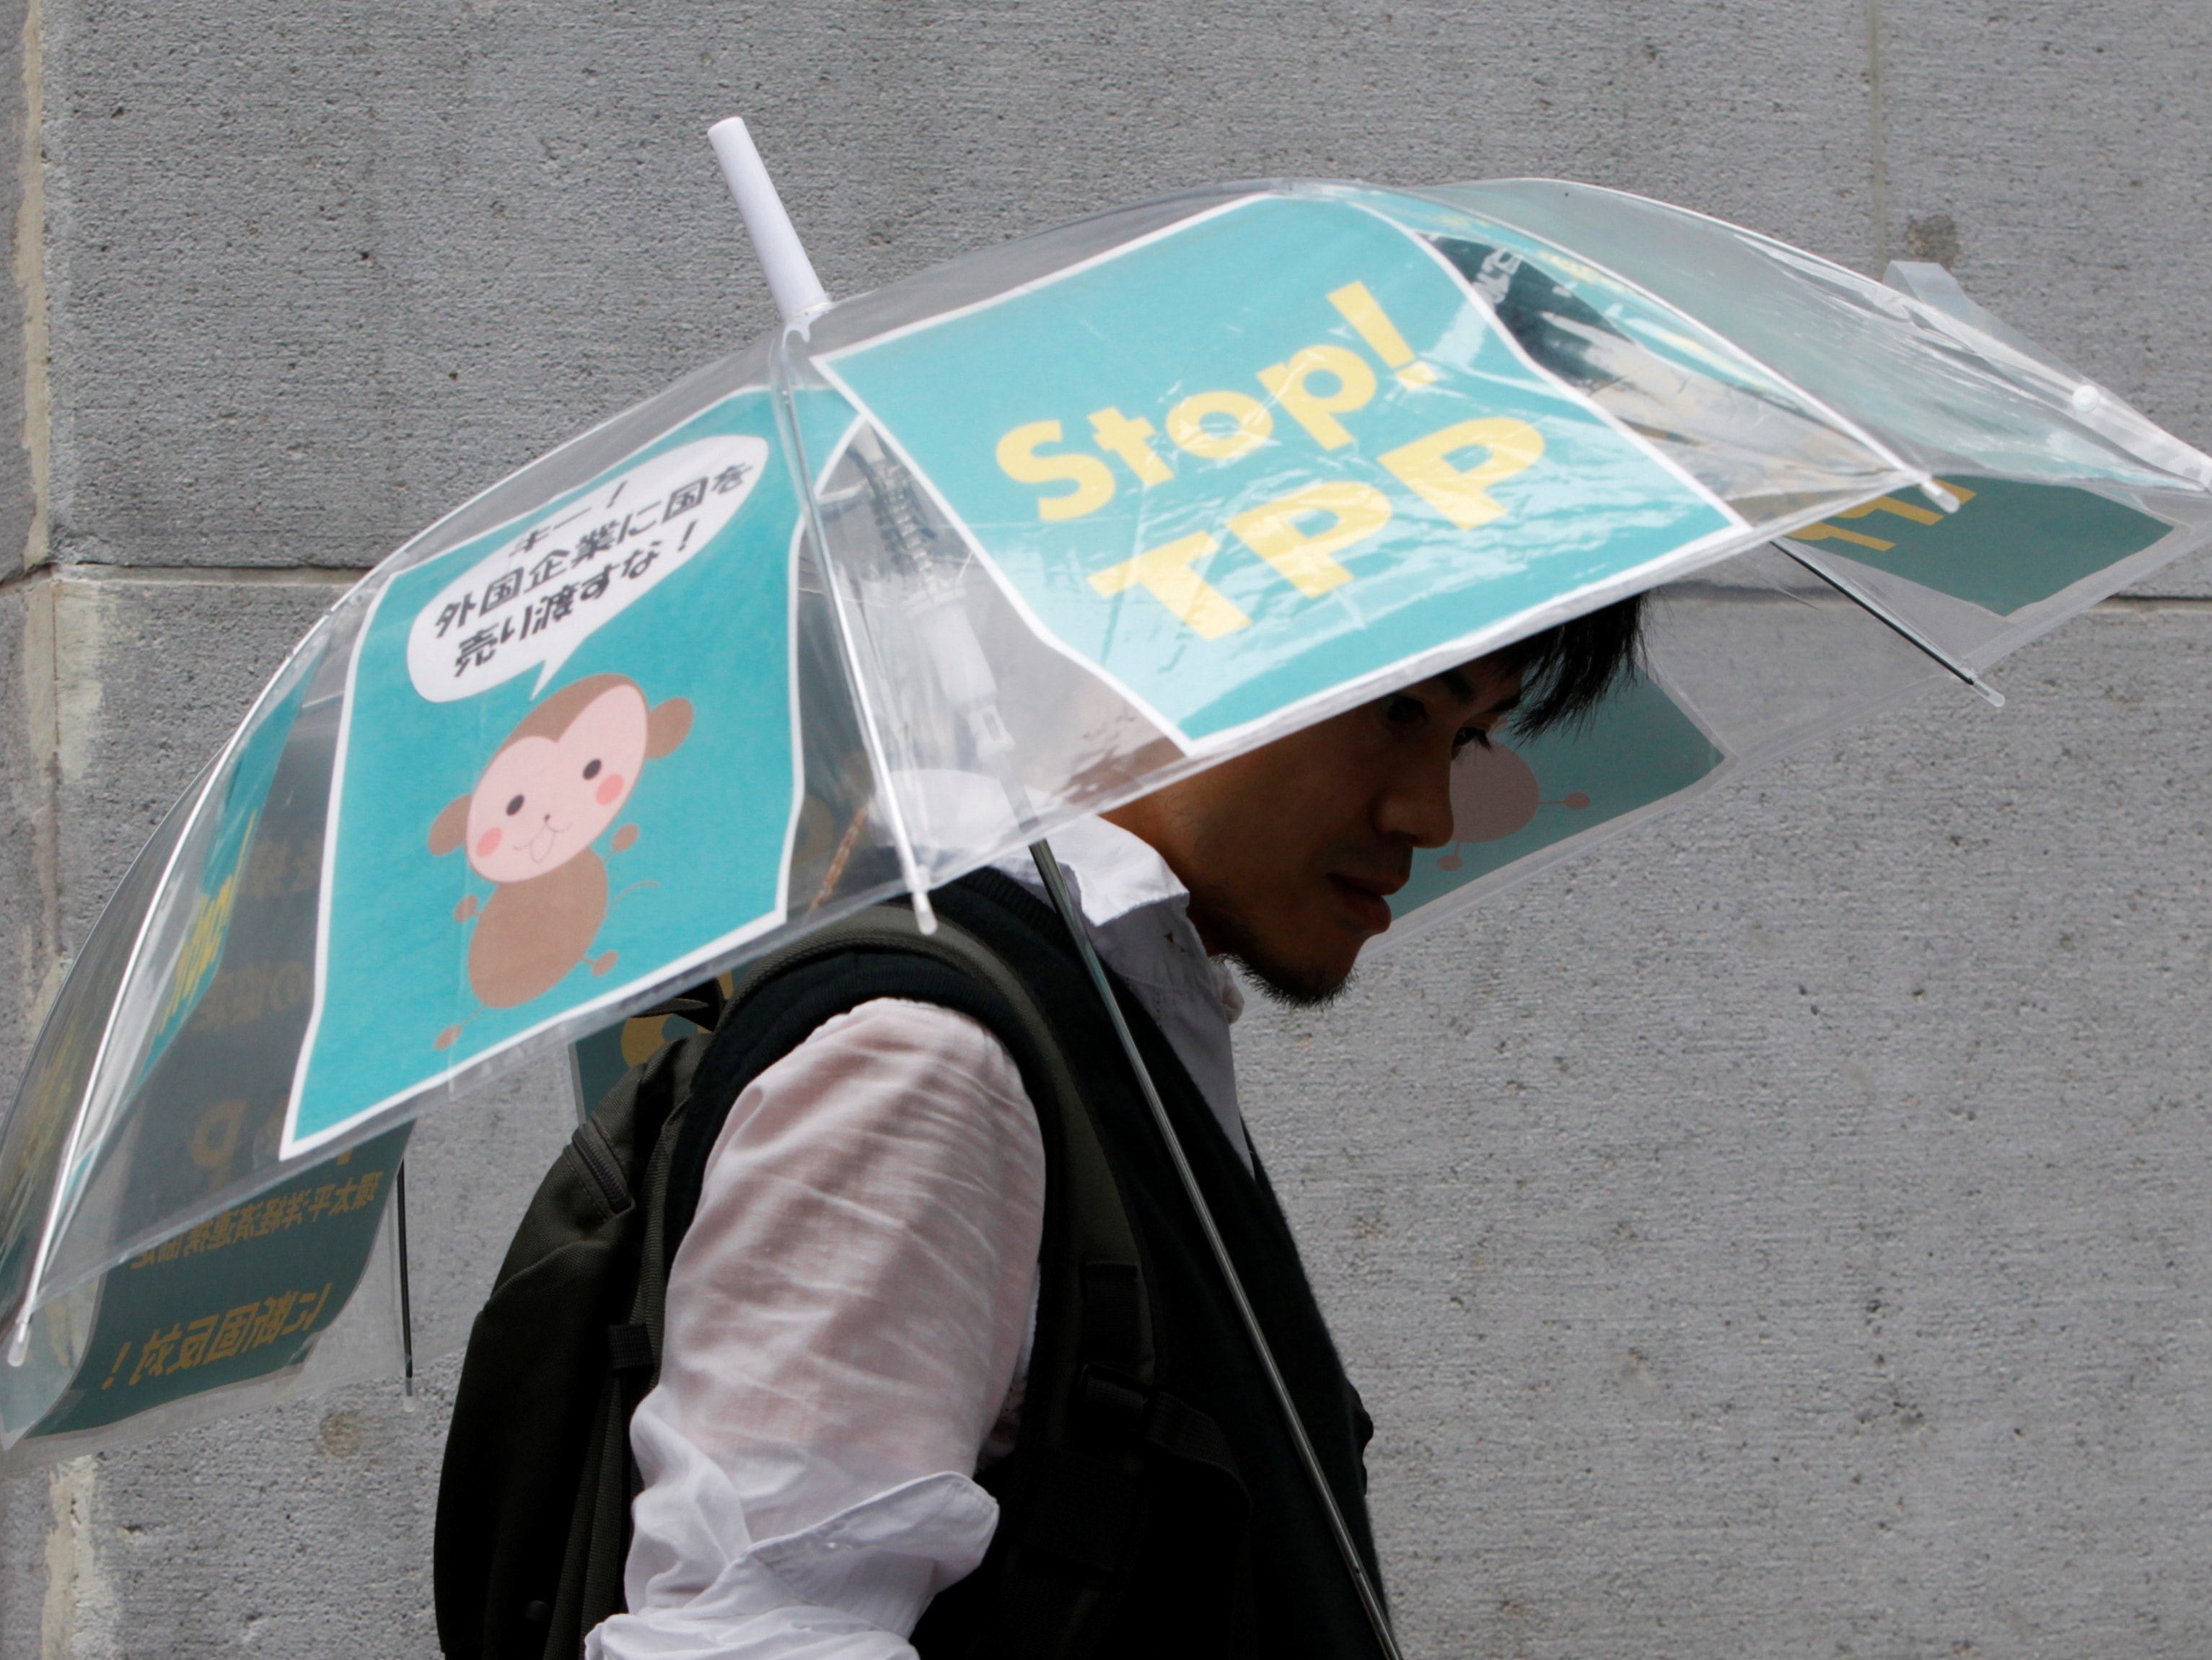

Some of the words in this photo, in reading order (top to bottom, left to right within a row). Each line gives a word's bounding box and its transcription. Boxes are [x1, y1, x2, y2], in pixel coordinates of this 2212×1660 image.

[996, 280, 1437, 522] Stop!
[435, 463, 753, 638] 外国企業に国を
[454, 520, 698, 677] 売り渡すな！
[509, 480, 629, 557] キー！
[1087, 417, 1545, 641] TPP
